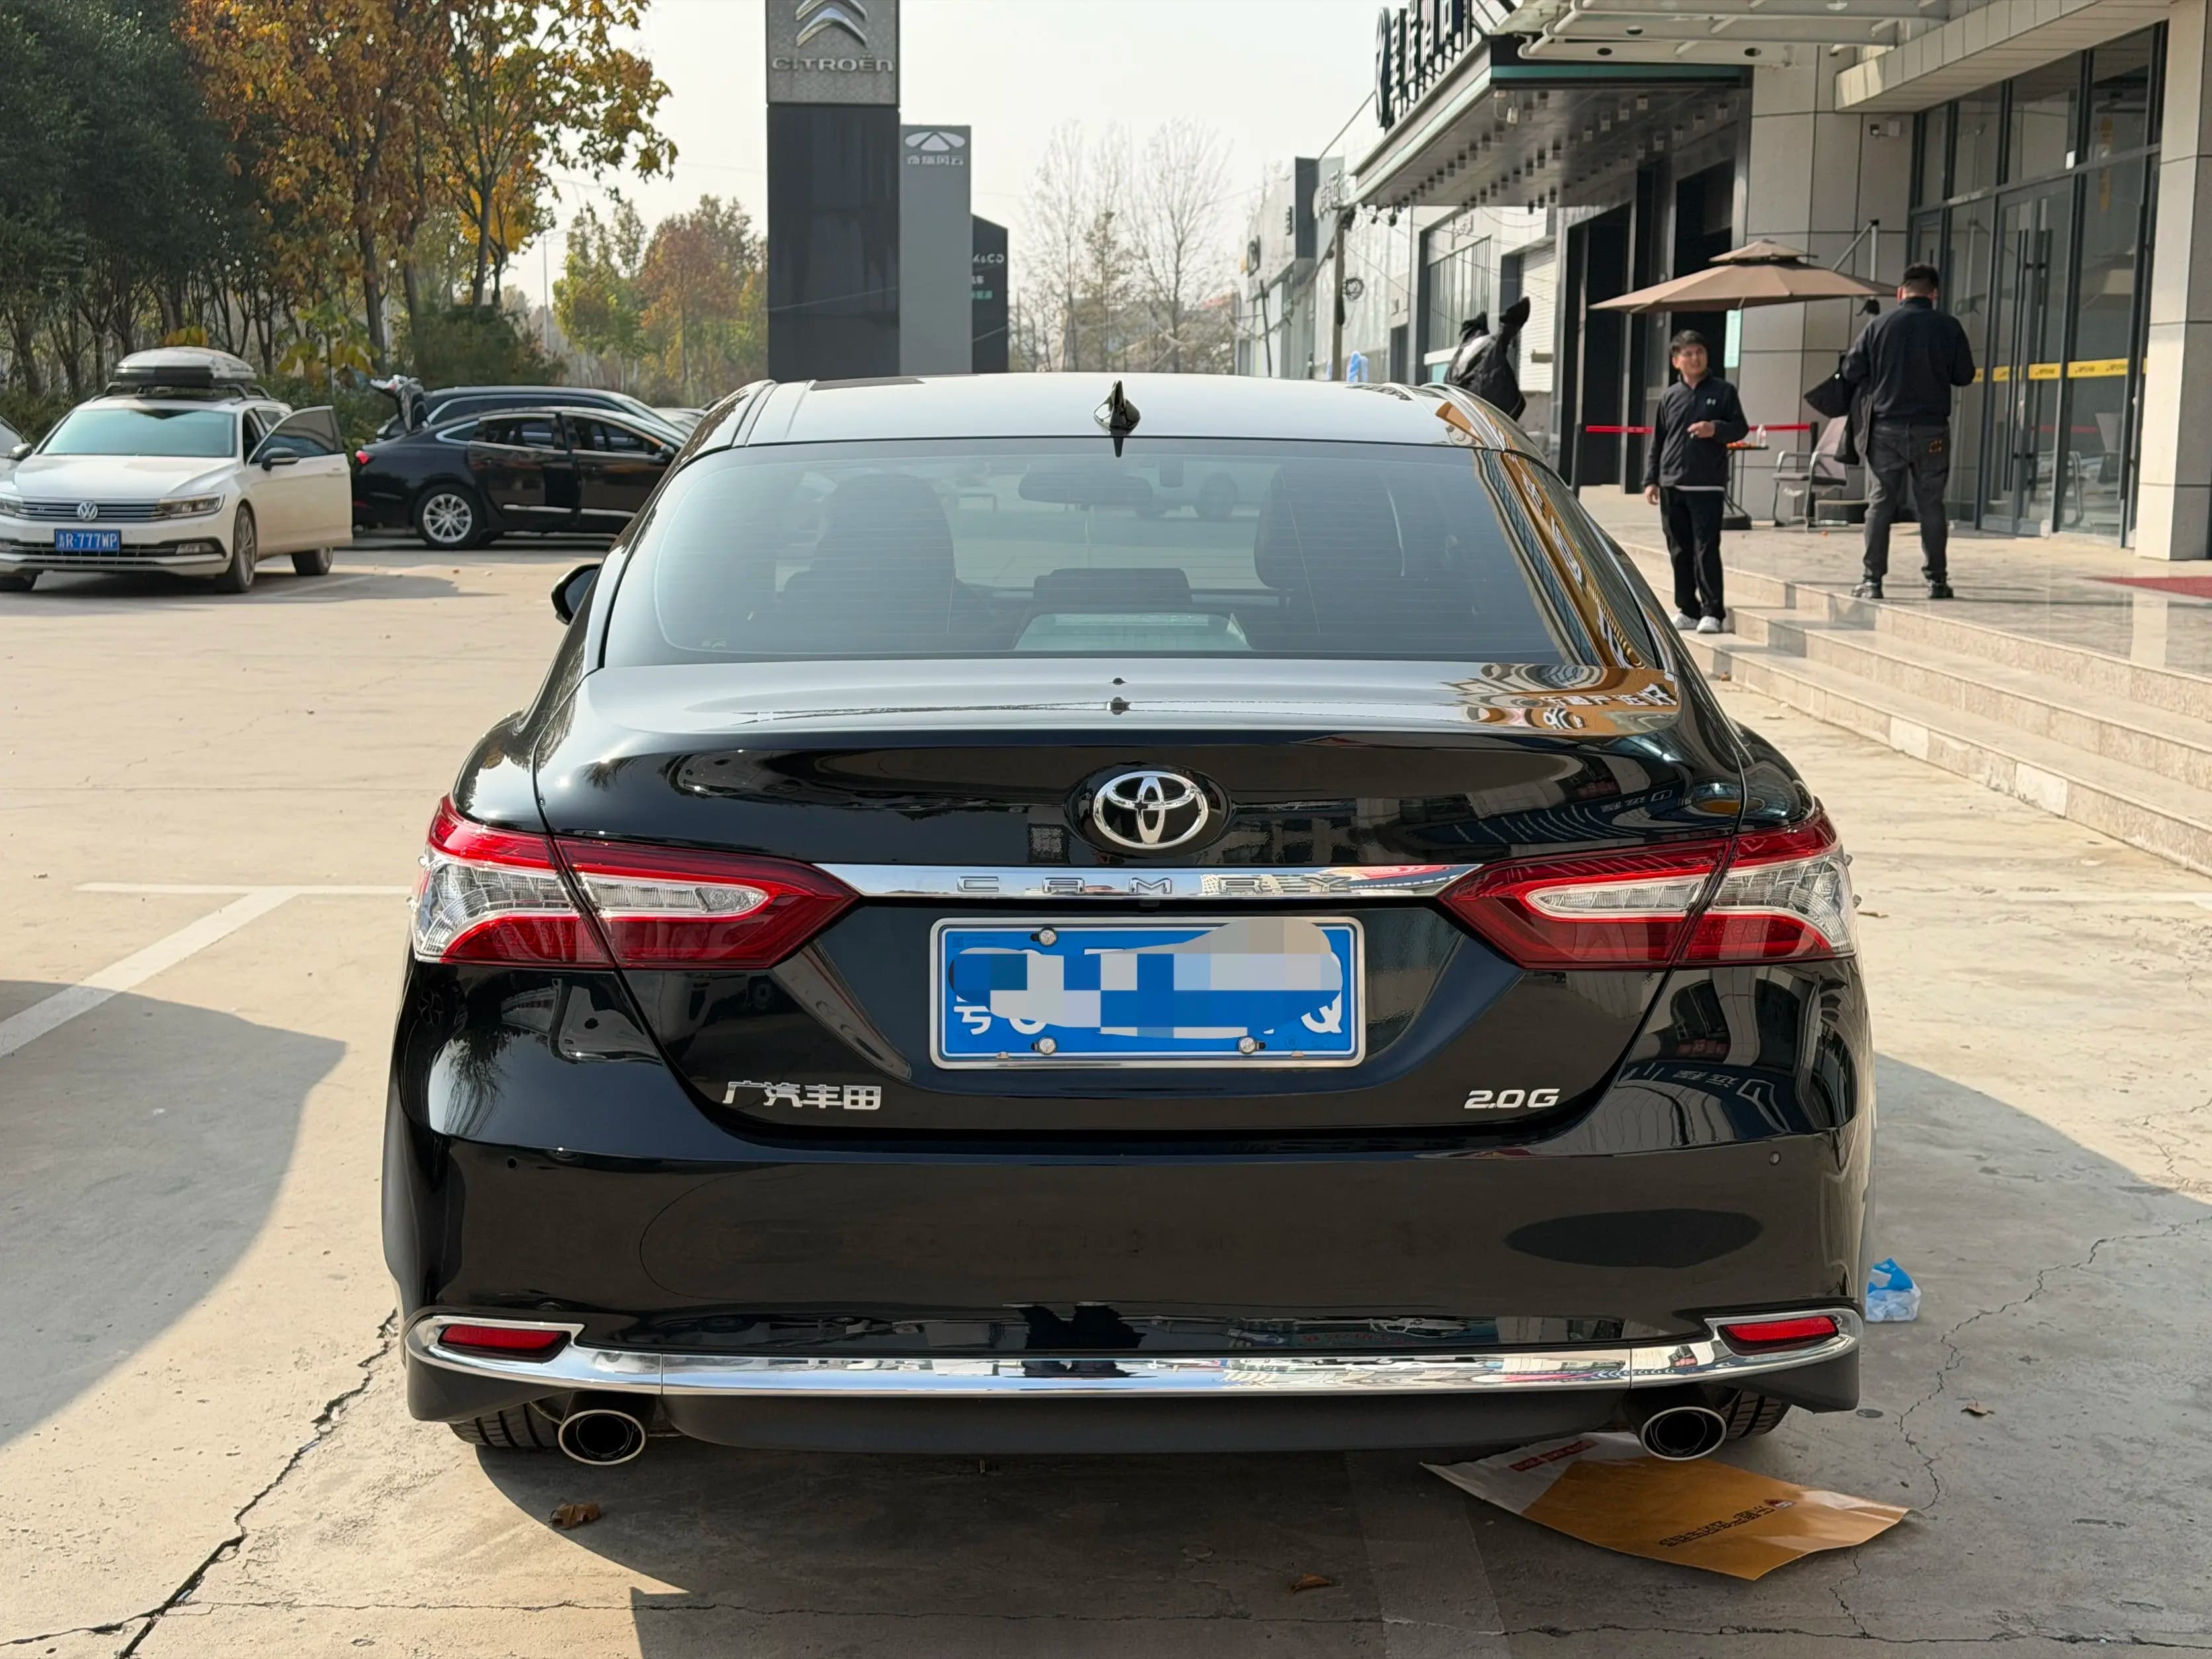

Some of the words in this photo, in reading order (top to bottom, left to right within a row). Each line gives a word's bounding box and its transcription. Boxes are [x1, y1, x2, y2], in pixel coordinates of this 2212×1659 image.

[957, 875, 1353, 895] CAMRY
[722, 1080, 882, 1110] 广汽丰田
[1464, 1088, 1561, 1109] 2.0G
